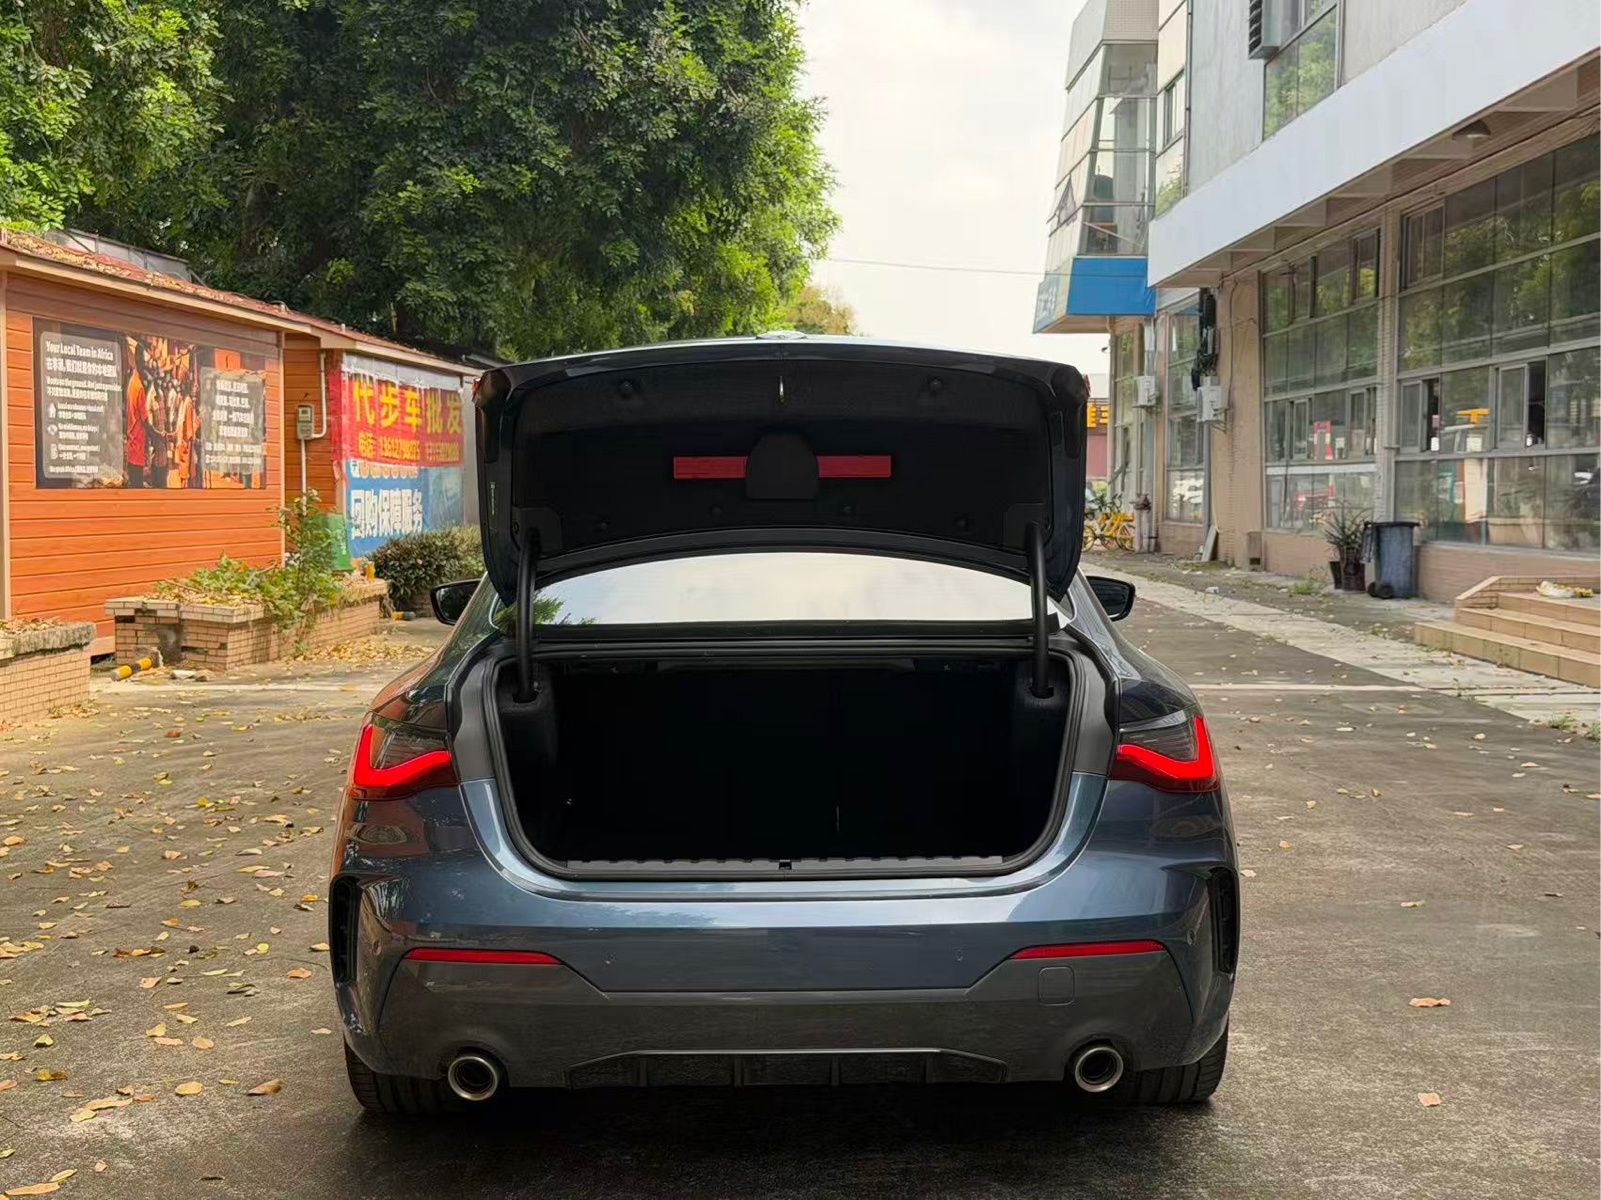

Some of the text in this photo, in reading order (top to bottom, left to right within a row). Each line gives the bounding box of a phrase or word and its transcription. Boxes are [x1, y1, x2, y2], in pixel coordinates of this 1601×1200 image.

[46, 341, 113, 360] Your Local Team in Africa
[353, 379, 461, 434] 代步车批发
